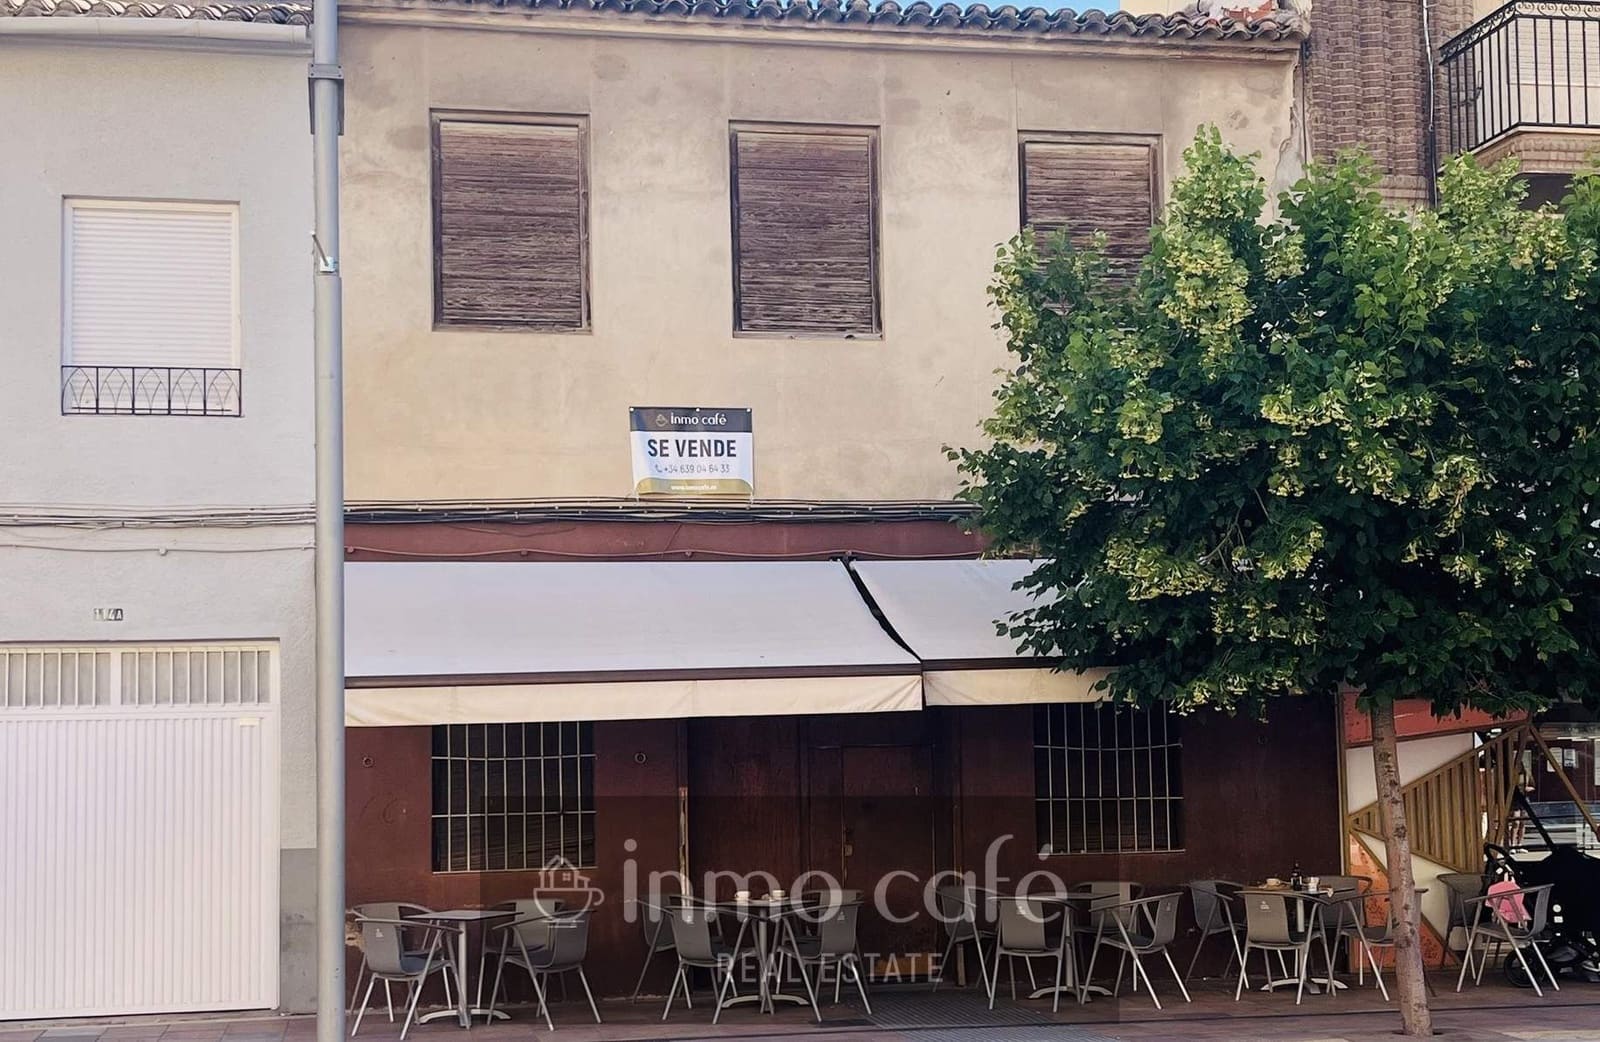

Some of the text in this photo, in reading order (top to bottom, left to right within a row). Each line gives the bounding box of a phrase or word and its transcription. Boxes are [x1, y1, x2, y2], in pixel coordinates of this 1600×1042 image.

[671, 412, 727, 425] inmo café
[647, 439, 737, 457] SE VENDE
[93, 608, 123, 621] 114A
